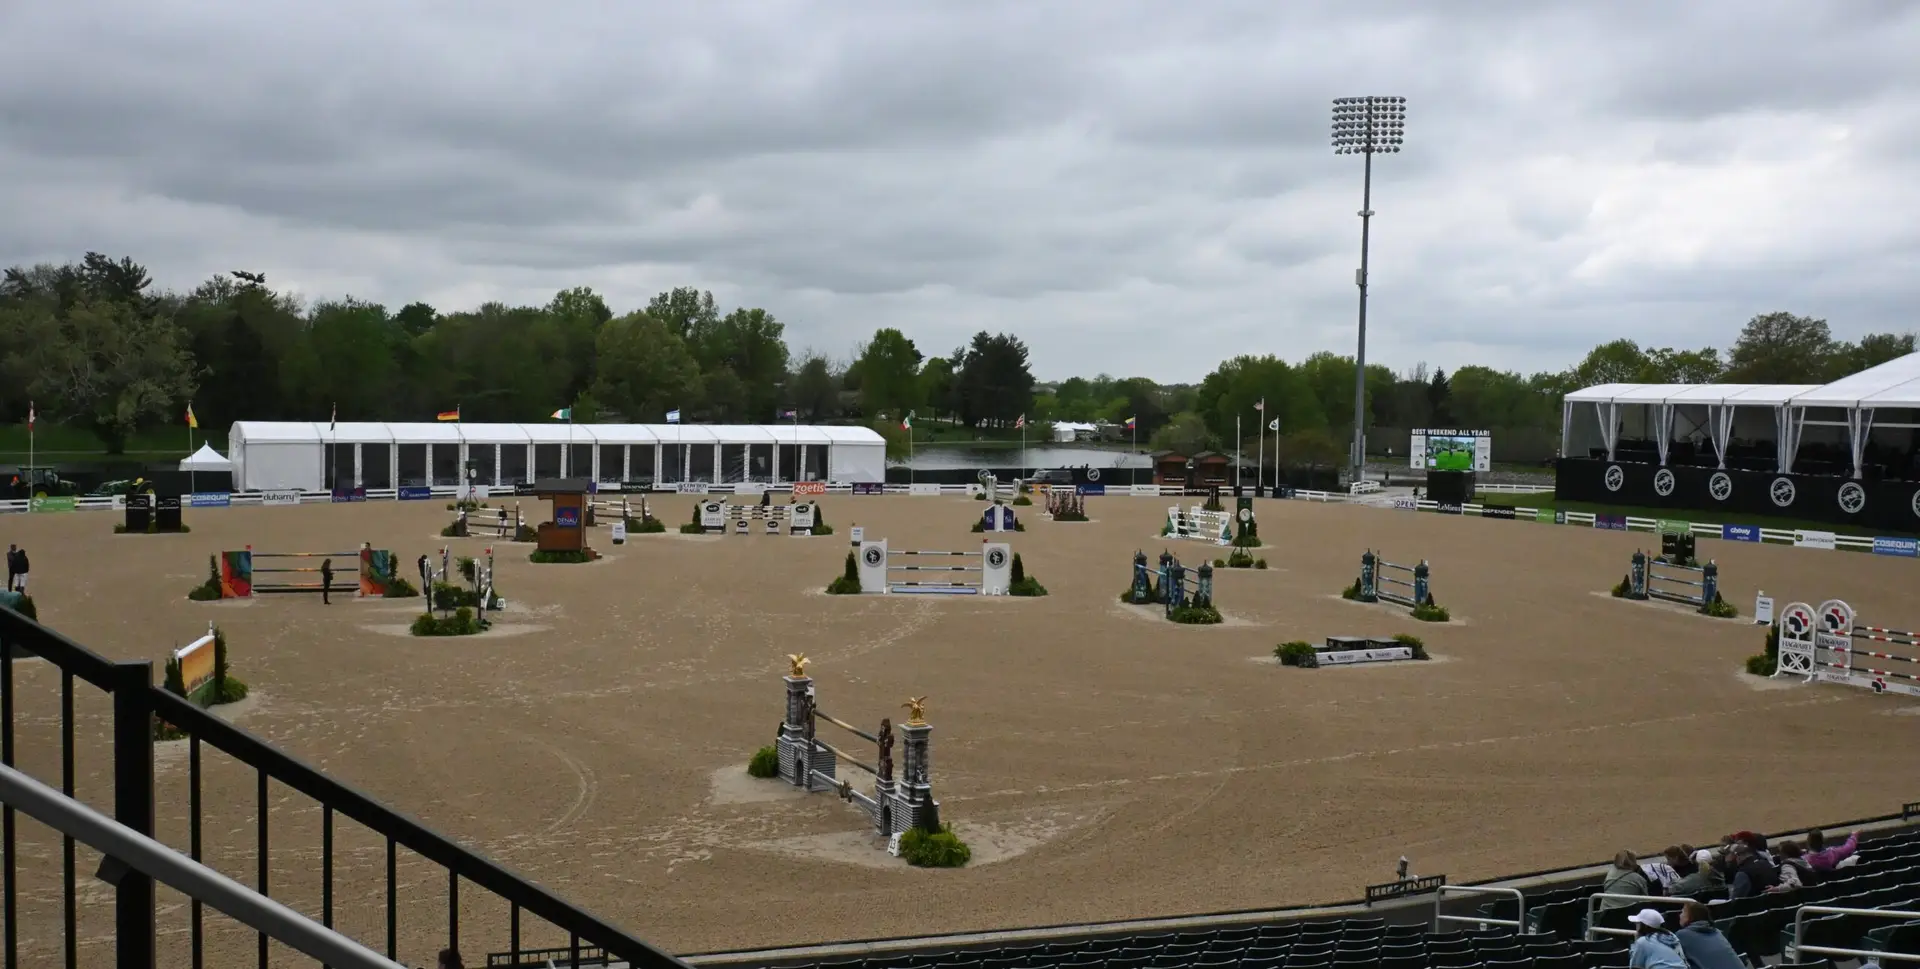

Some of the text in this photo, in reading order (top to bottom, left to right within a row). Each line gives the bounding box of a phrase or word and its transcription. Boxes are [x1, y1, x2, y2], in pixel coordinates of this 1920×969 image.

[794, 482, 825, 494] zoetis
[263, 494, 295, 502] dubarry
[1395, 500, 1415, 508] OPEN
[1437, 503, 1461, 511] LeMieux
[1874, 539, 1916, 549] COSEQUIN
[1782, 640, 1812, 650] HAGYARD
[1819, 637, 1849, 647] HAGYARD
